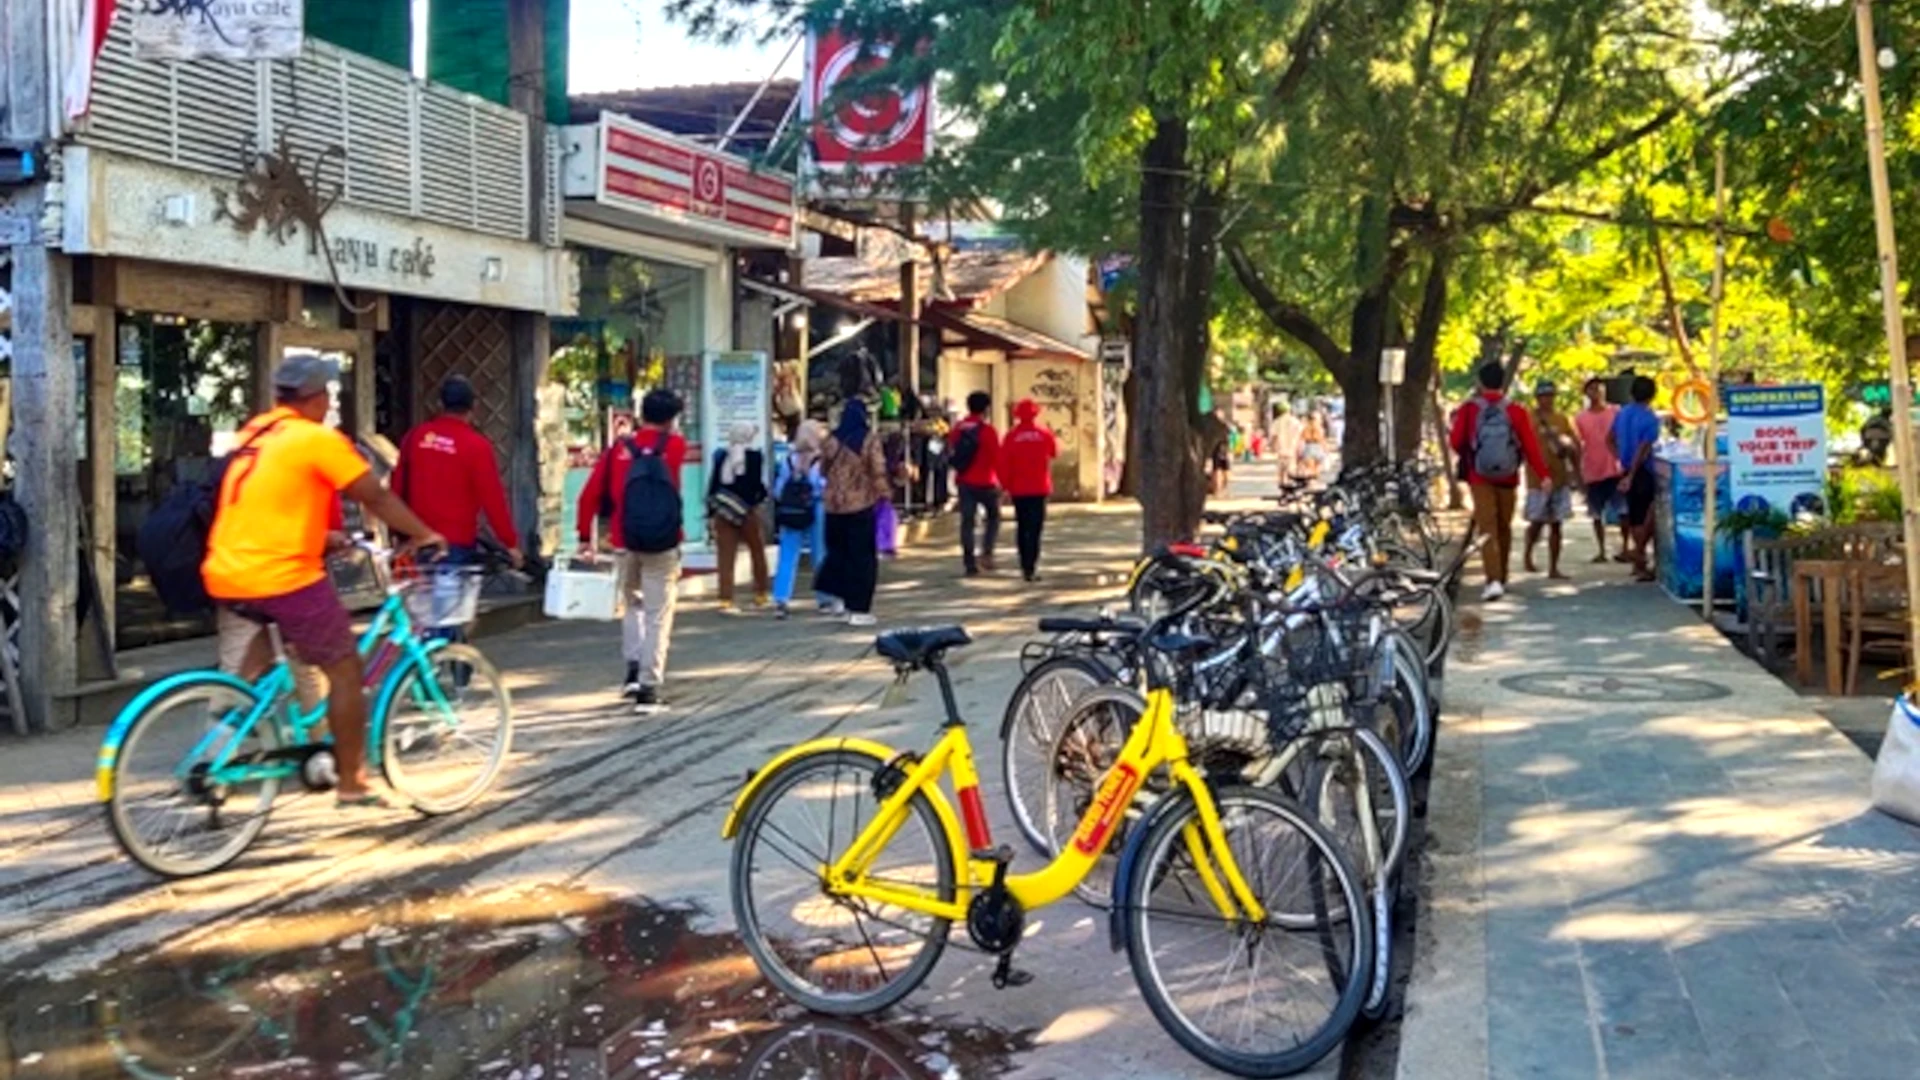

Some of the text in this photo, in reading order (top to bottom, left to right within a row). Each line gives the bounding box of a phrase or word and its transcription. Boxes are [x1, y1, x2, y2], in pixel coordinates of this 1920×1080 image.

[1755, 426, 1797, 438] BOOK
[1737, 438, 1818, 452] YOUR TRIP
[1752, 453, 1794, 465] HERE
